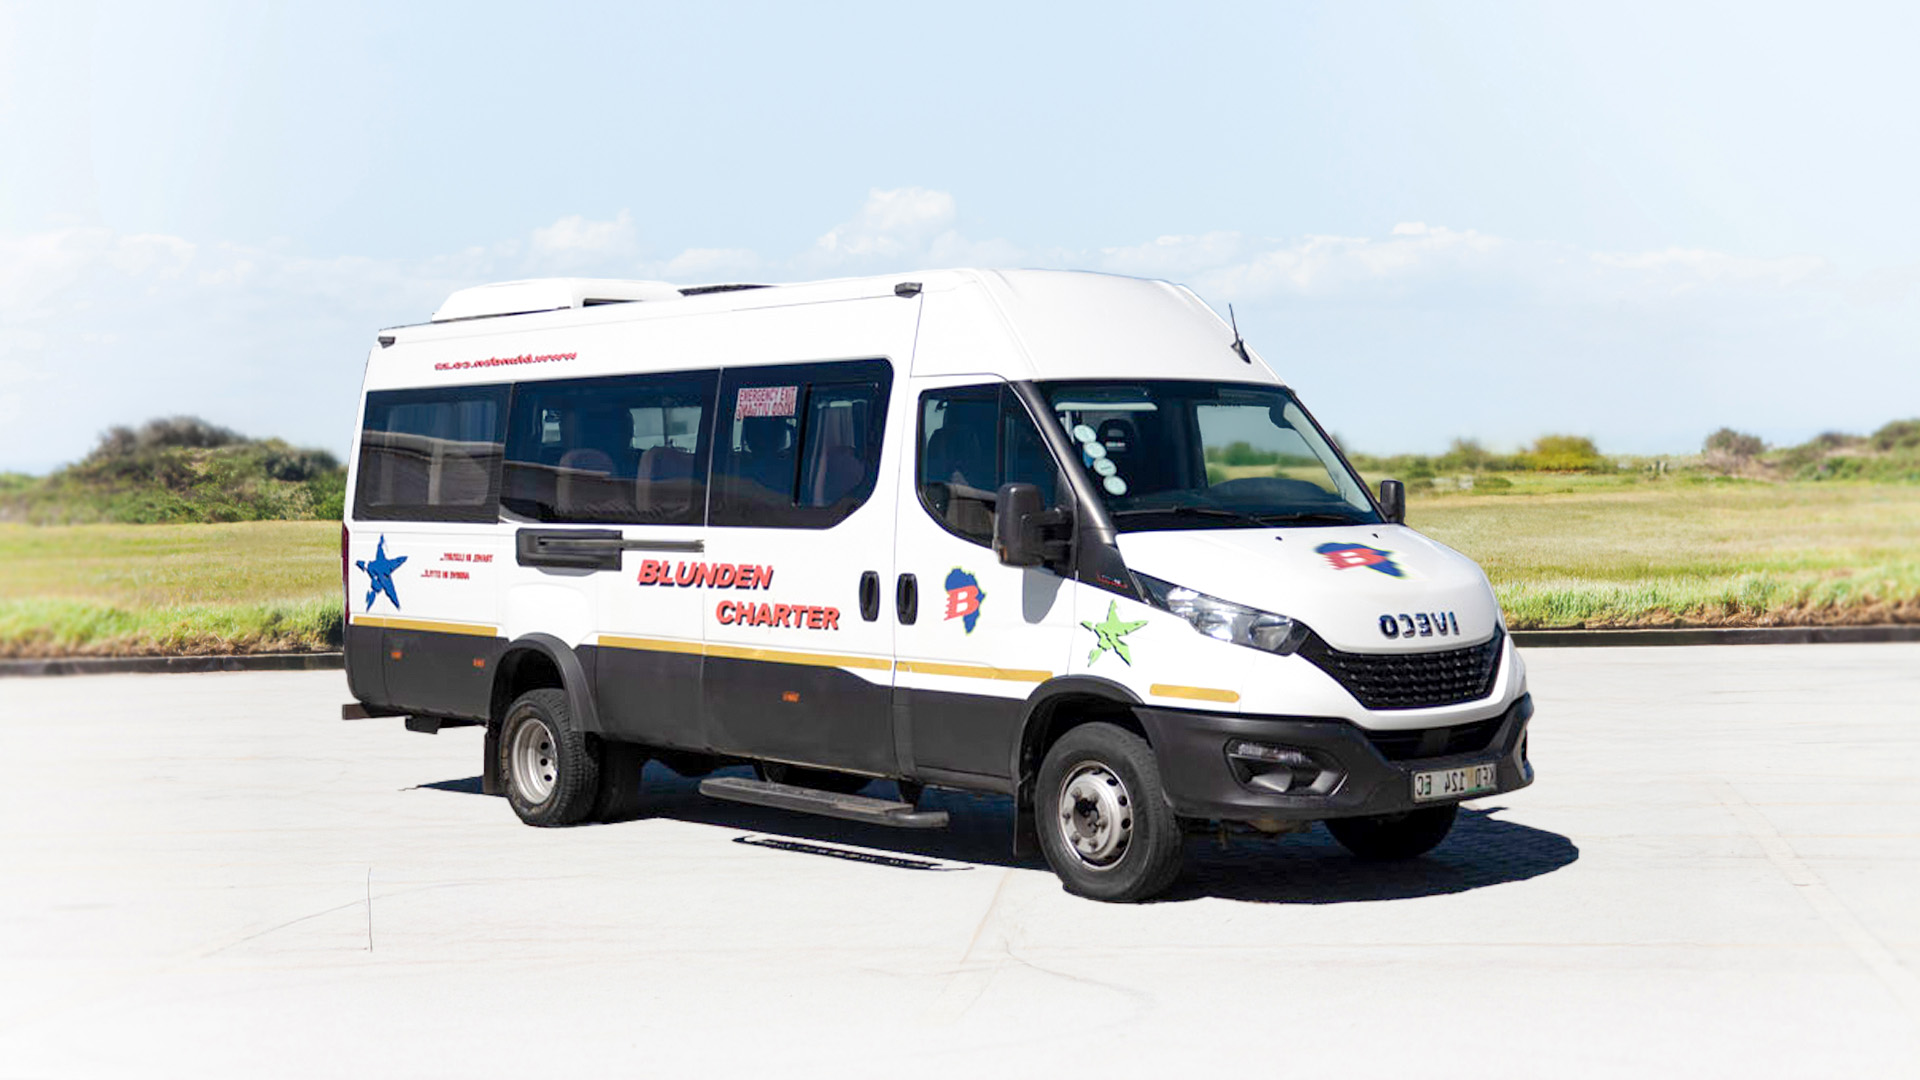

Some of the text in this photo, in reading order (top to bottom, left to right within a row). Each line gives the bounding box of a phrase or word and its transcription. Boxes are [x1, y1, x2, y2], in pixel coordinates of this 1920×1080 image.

[637, 559, 774, 590] BLUNDEN
[715, 600, 841, 630] CHARTER
[943, 585, 980, 621] B
